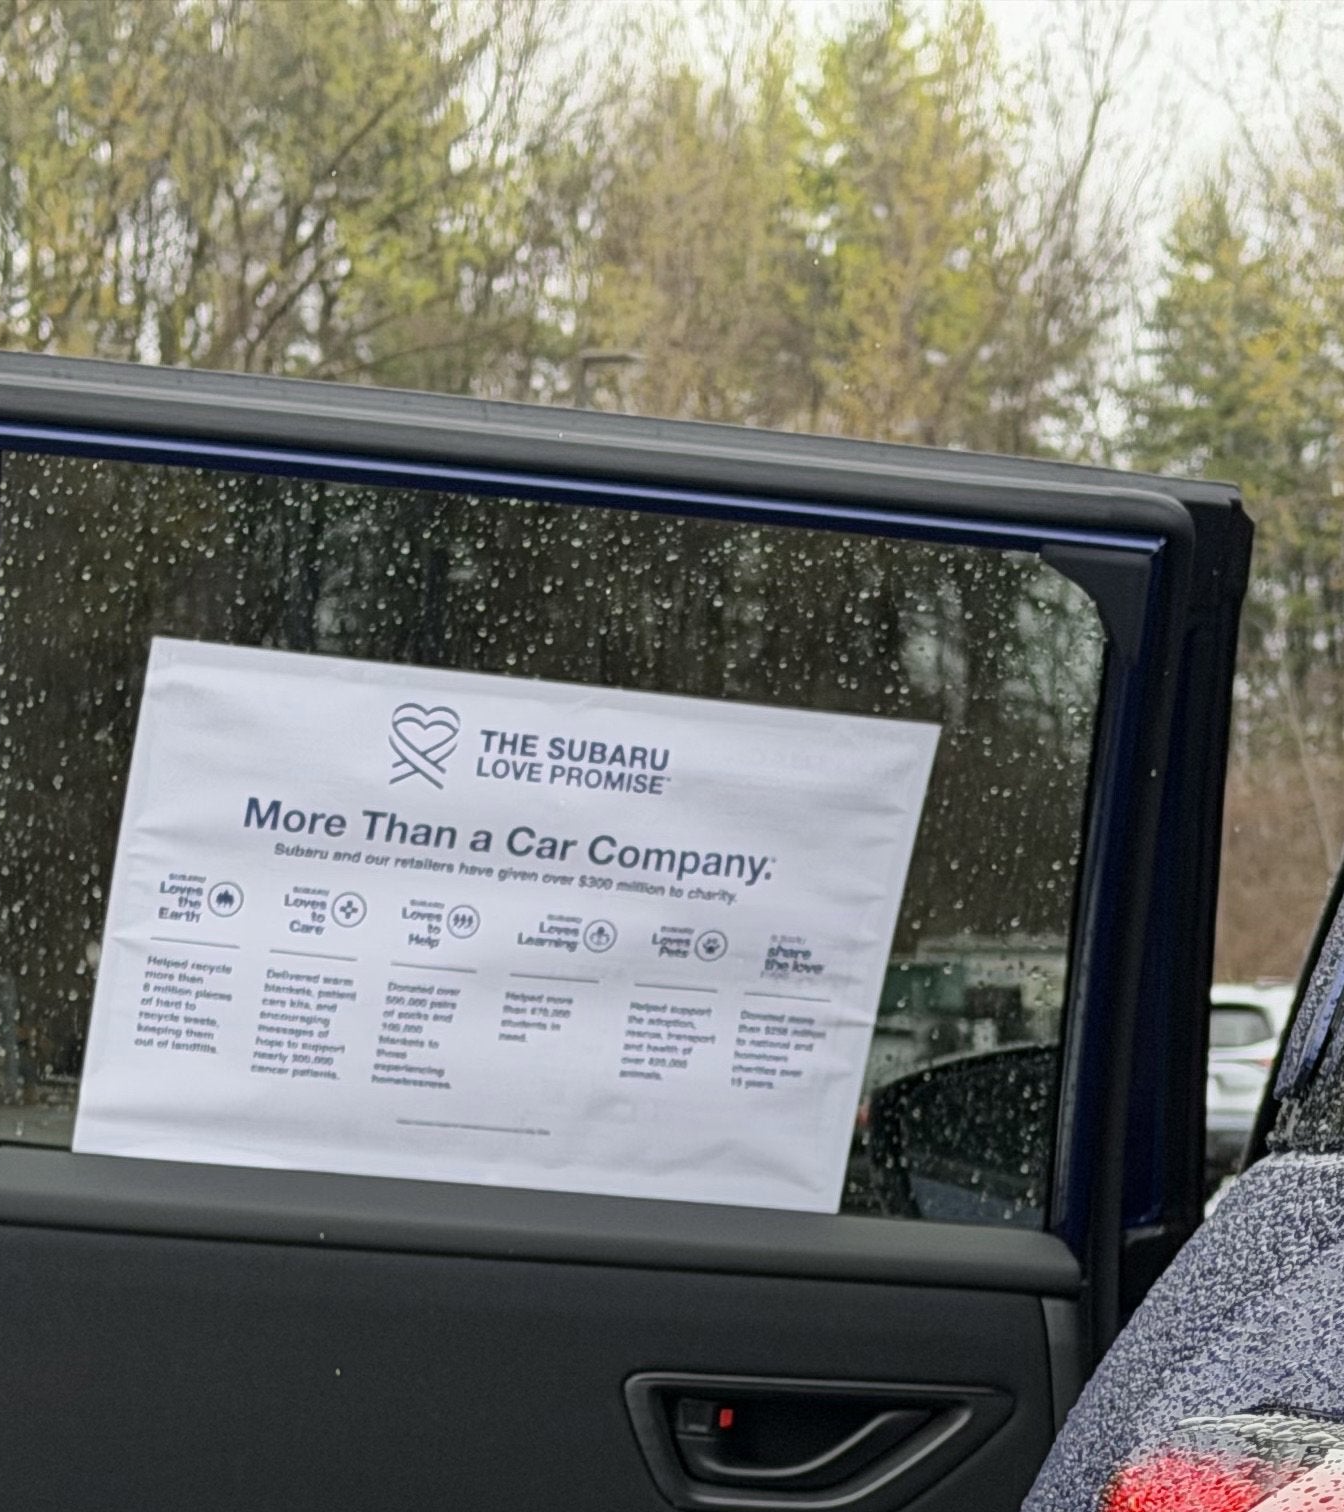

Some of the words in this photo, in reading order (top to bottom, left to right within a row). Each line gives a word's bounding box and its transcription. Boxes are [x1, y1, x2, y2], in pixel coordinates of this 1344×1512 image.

[480, 729, 539, 757] THE
[547, 737, 671, 771] SUBARU
[476, 756, 543, 783] LOVE
[243, 797, 347, 837] More
[362, 809, 458, 849] Than
[469, 828, 493, 853] a
[507, 826, 578, 862] Car
[275, 842, 329, 860] Subaru
[333, 851, 361, 863] and
[365, 856, 391, 867] our
[394, 857, 454, 873] retailers
[460, 863, 494, 878] have
[498, 866, 538, 884] given
[542, 873, 574, 887] over
[578, 873, 614, 892] $300
[616, 879, 665, 895] million
[670, 883, 684, 898] to
[159, 881, 203, 896] Loves
[178, 897, 202, 908] the
[284, 894, 327, 909] Loves
[158, 907, 203, 922] Earth
[311, 912, 325, 923] to
[402, 908, 443, 922] Loves
[289, 920, 324, 935] Care
[428, 924, 441, 934] to
[539, 922, 580, 937] Loves
[408, 933, 440, 949] Help
[517, 933, 579, 952] Learning
[652, 933, 691, 947] Loves
[659, 947, 689, 959] Pets
[767, 946, 811, 961] share
[147, 955, 188, 969] Helped
[764, 959, 789, 971] the
[792, 961, 823, 974] love
[145, 971, 174, 981] more
[141, 997, 153, 1006] of
[156, 998, 182, 1009] hard
[185, 1001, 196, 1011] to
[139, 1010, 179, 1022] recycle
[157, 1040, 168, 1048] of
[287, 1040, 298, 1048] to
